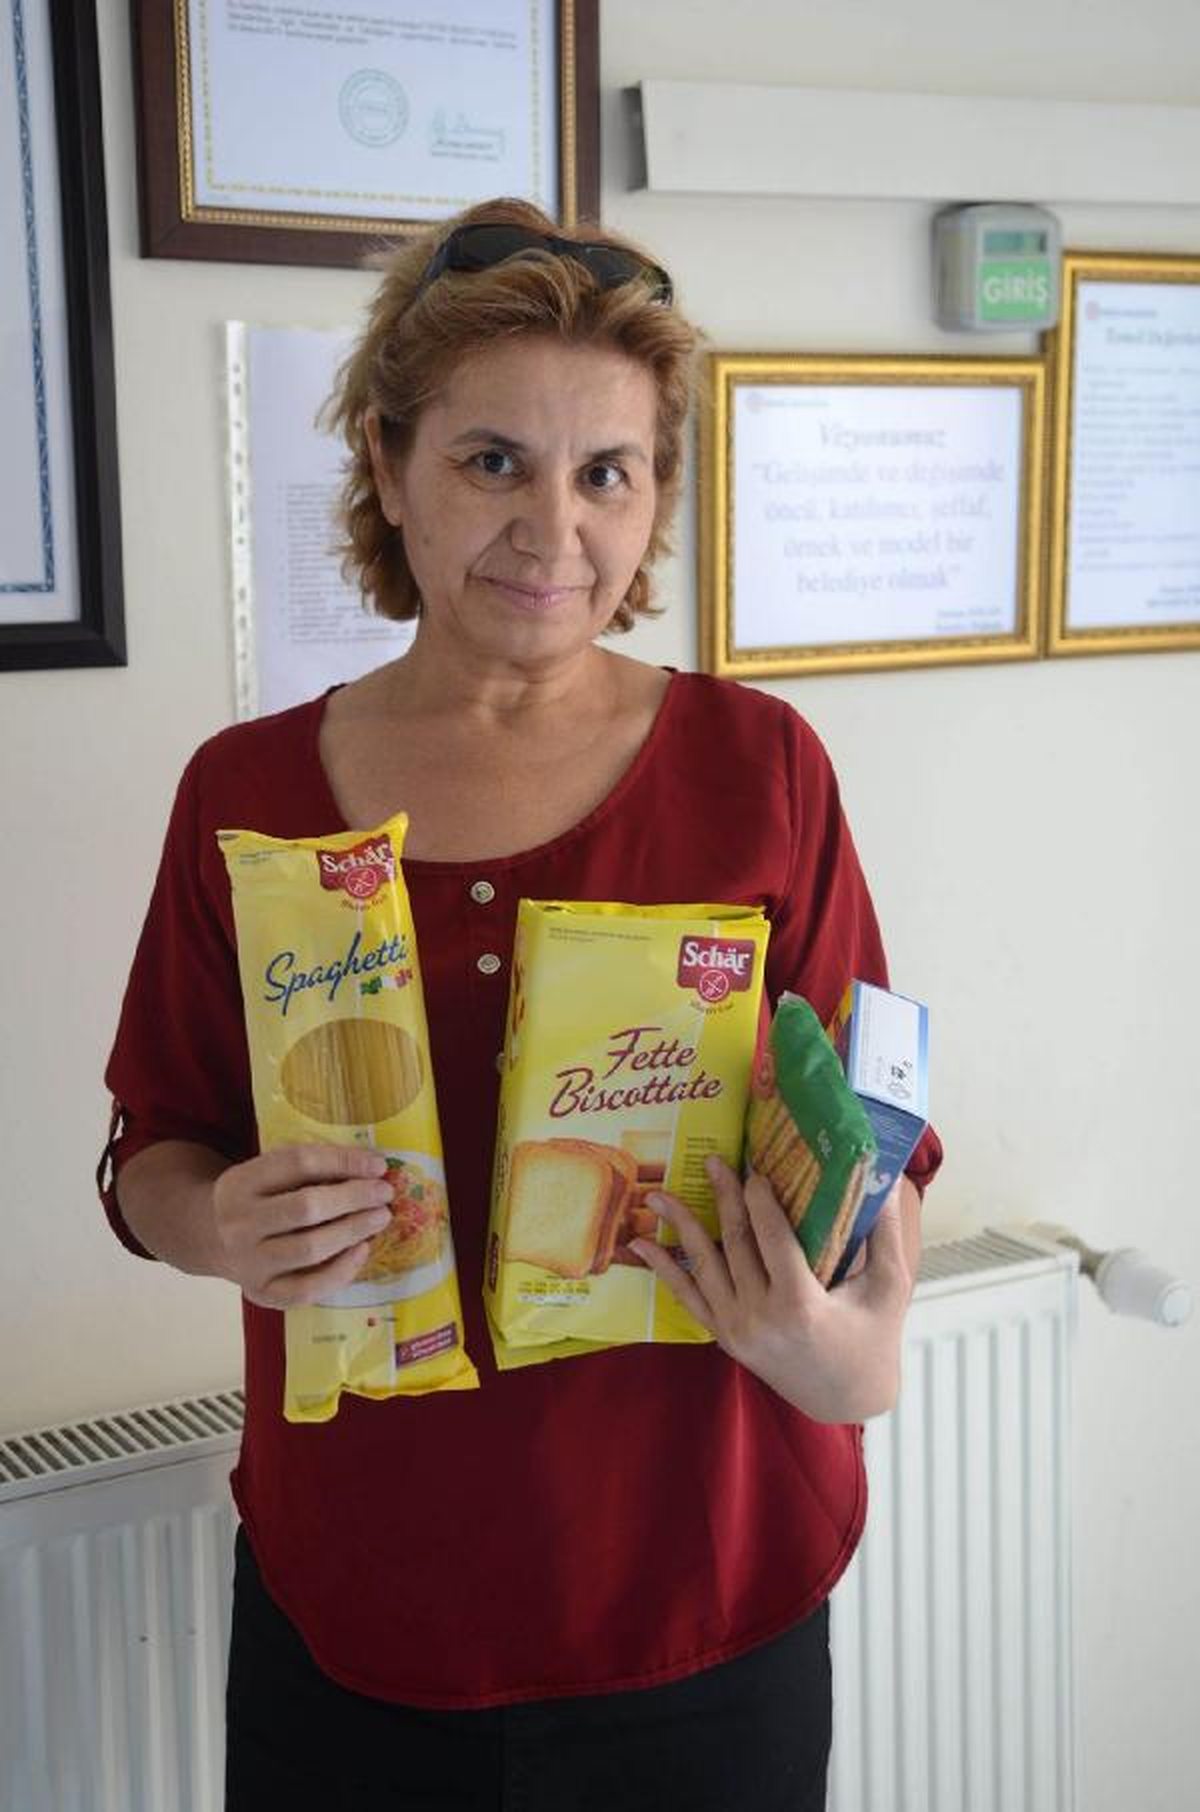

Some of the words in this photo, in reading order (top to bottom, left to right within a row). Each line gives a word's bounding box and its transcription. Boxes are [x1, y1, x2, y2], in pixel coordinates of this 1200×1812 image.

[983, 266, 1048, 312] GİRİŞ
[946, 529, 976, 553] bir
[321, 841, 396, 878] Schär
[264, 931, 407, 1016] Spaghetti
[682, 941, 750, 975] Schär
[602, 1027, 698, 1080] Fette
[549, 1067, 723, 1119] Biscottate
